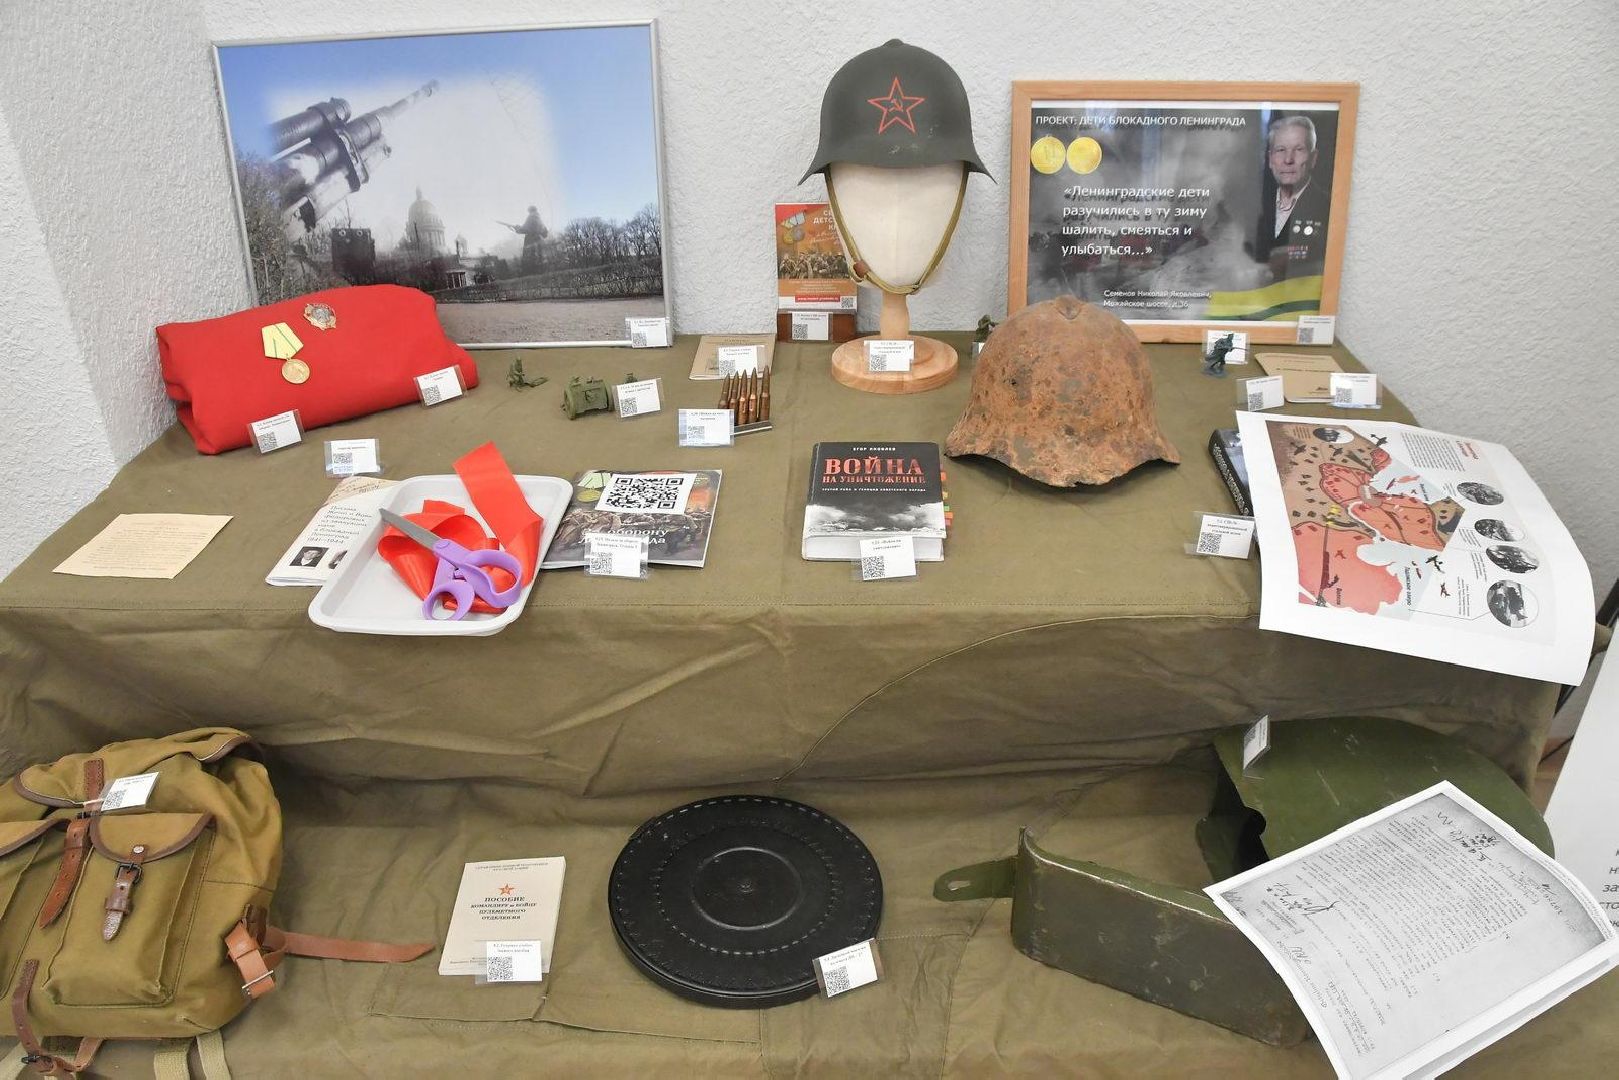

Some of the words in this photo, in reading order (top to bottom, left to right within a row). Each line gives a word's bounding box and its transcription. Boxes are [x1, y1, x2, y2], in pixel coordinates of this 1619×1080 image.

[1035, 115, 1077, 126] ПРОЕКТ:
[1079, 115, 1106, 126] ДЕТИ
[1108, 115, 1178, 127] БЛОКАДНОГО
[1179, 116, 1246, 126] ЛЕНИНГРАДА
[1064, 185, 1175, 199] «Ленинградские
[1178, 186, 1210, 199] дети
[1063, 206, 1140, 219] разучились
[1144, 207, 1153, 216] в
[1156, 207, 1171, 219] ту
[1174, 207, 1208, 219] зиму
[1062, 226, 1116, 236] шалить,
[1120, 226, 1180, 236] смеяться
[1183, 226, 1192, 235] и
[823, 456, 925, 475] ВОЙНА
[822, 475, 838, 484] НА
[839, 475, 926, 484] УНИЧТОЖЕНИЕ
[607, 528, 669, 537] оборону
